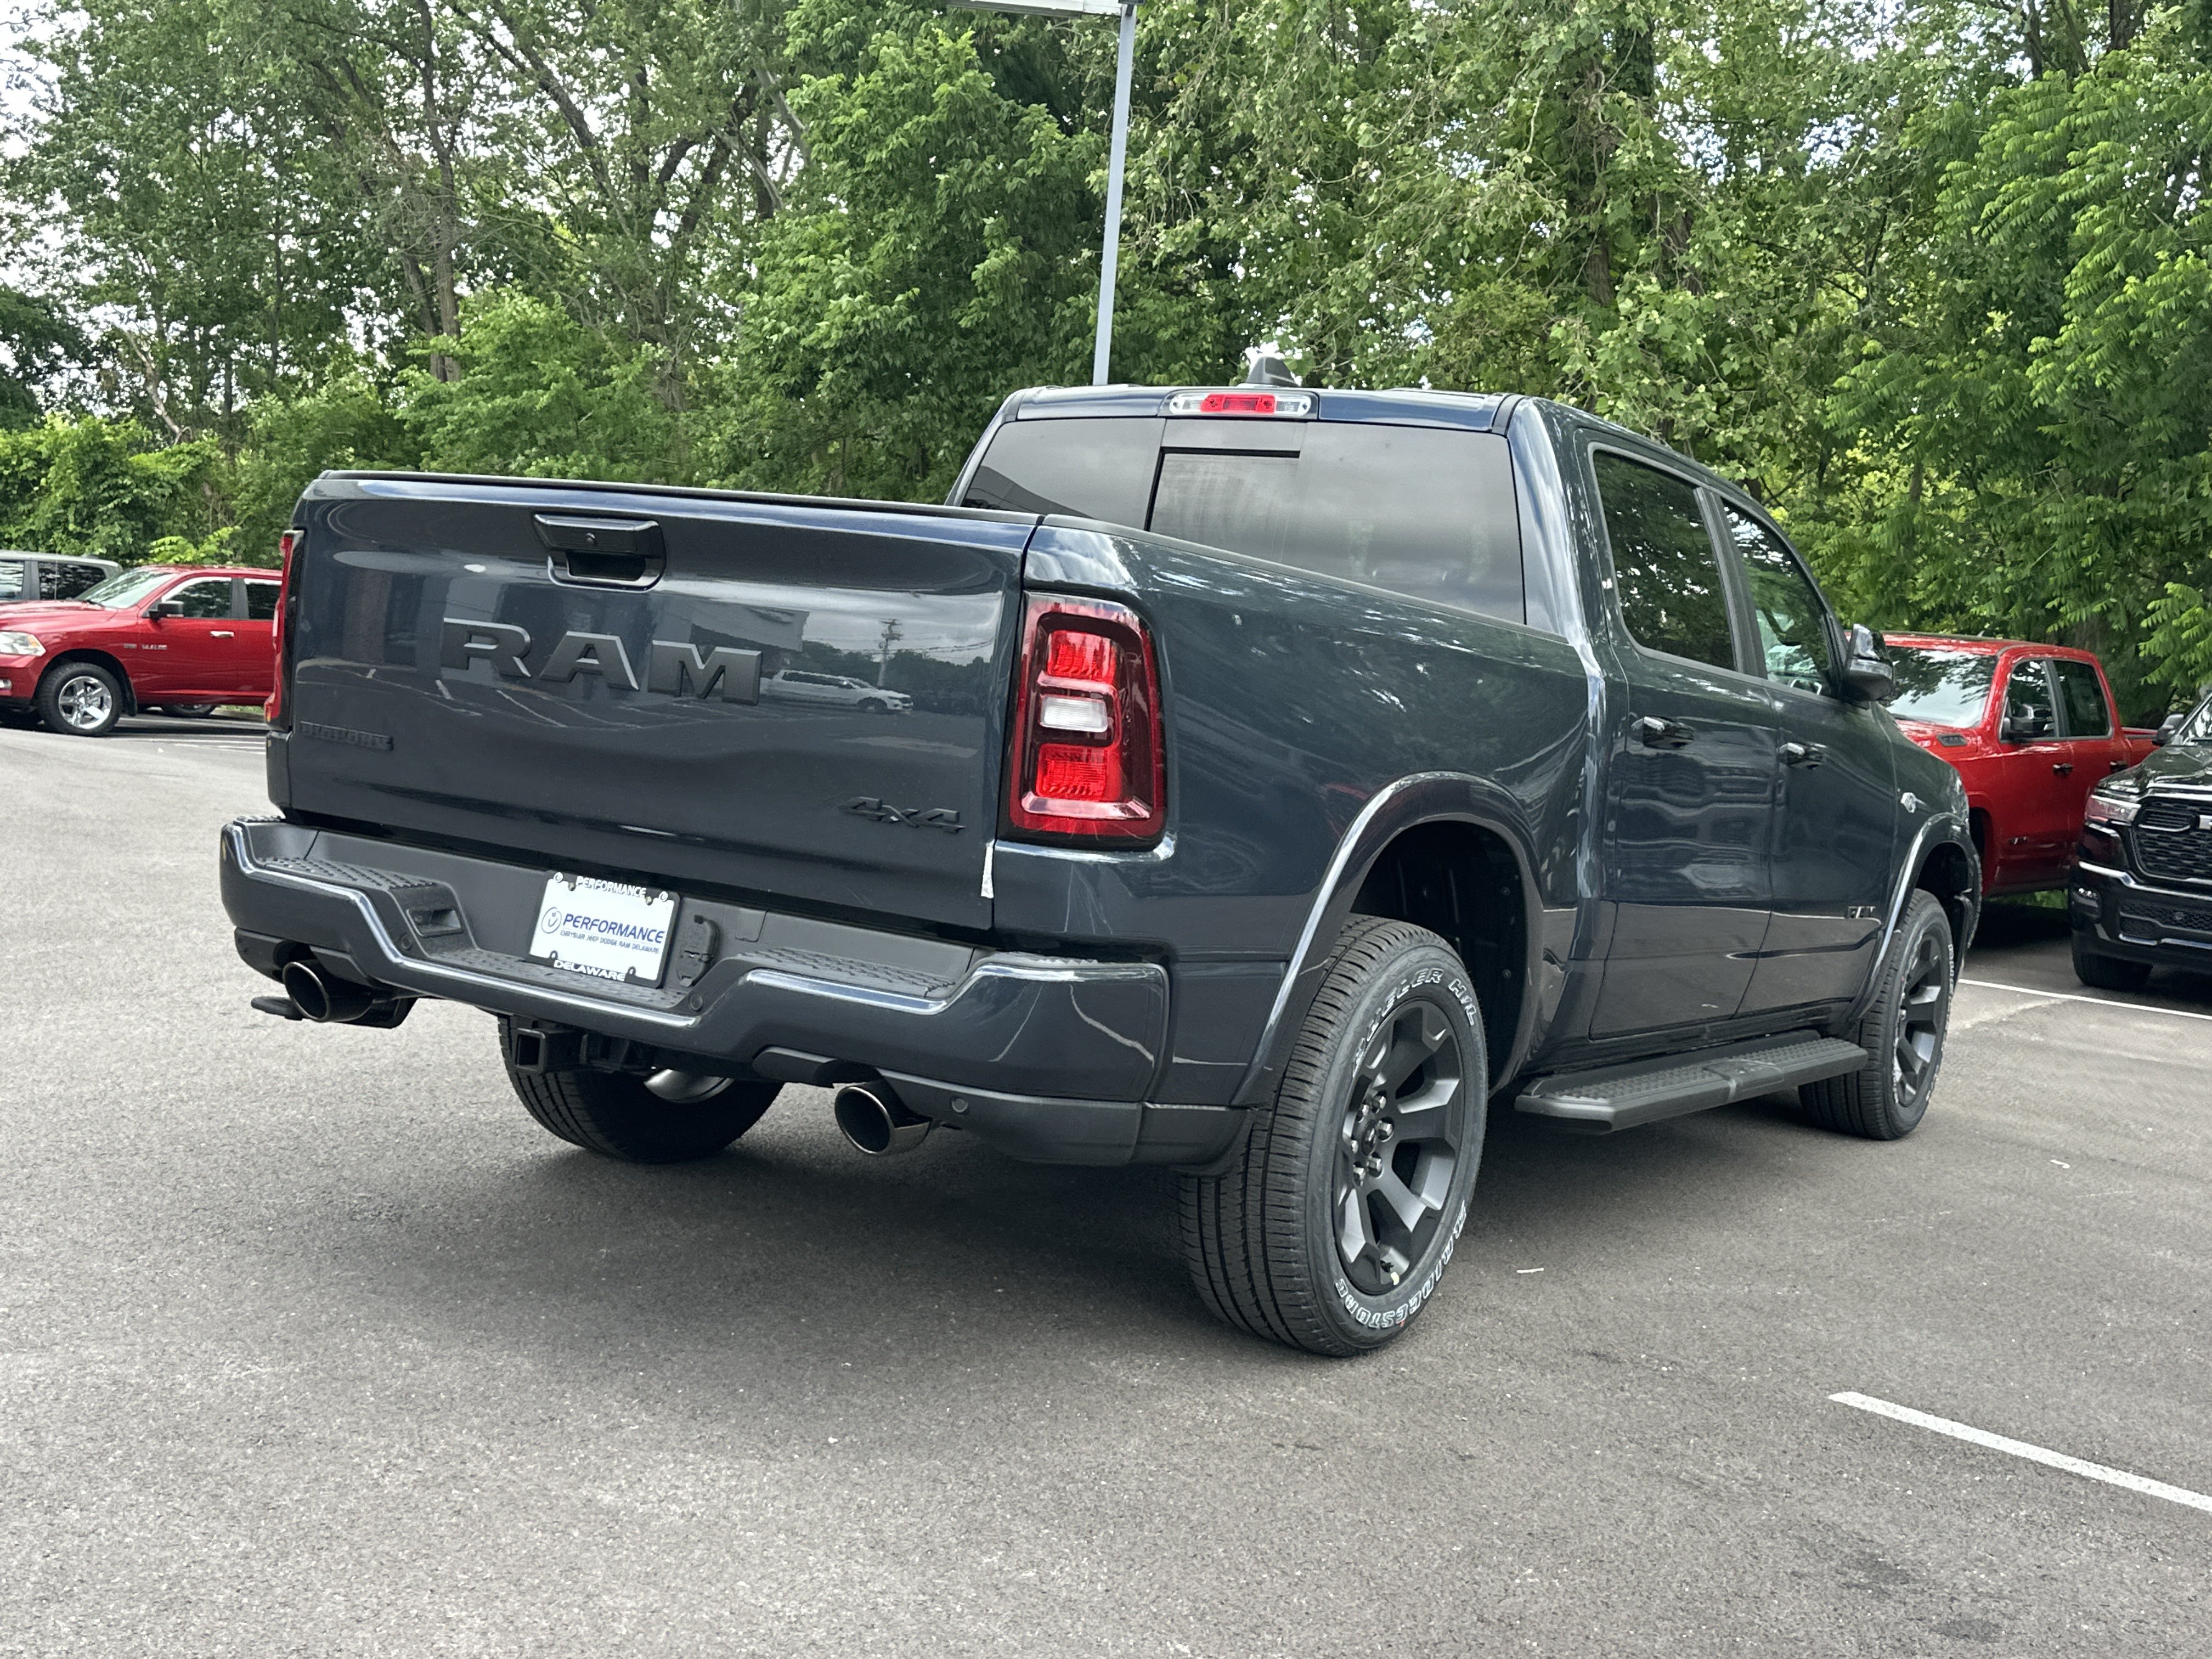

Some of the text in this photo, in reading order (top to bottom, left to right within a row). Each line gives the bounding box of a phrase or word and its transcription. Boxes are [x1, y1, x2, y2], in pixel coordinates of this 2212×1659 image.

[441, 617, 763, 706] RAM
[576, 876, 646, 899] PERFORMANCE
[560, 930, 585, 940] CHRYSLER
[600, 938, 617, 946] DODGE
[618, 940, 631, 949] RAM
[562, 913, 665, 944] PERFORMANCE
[554, 960, 625, 982] DELAWARE
